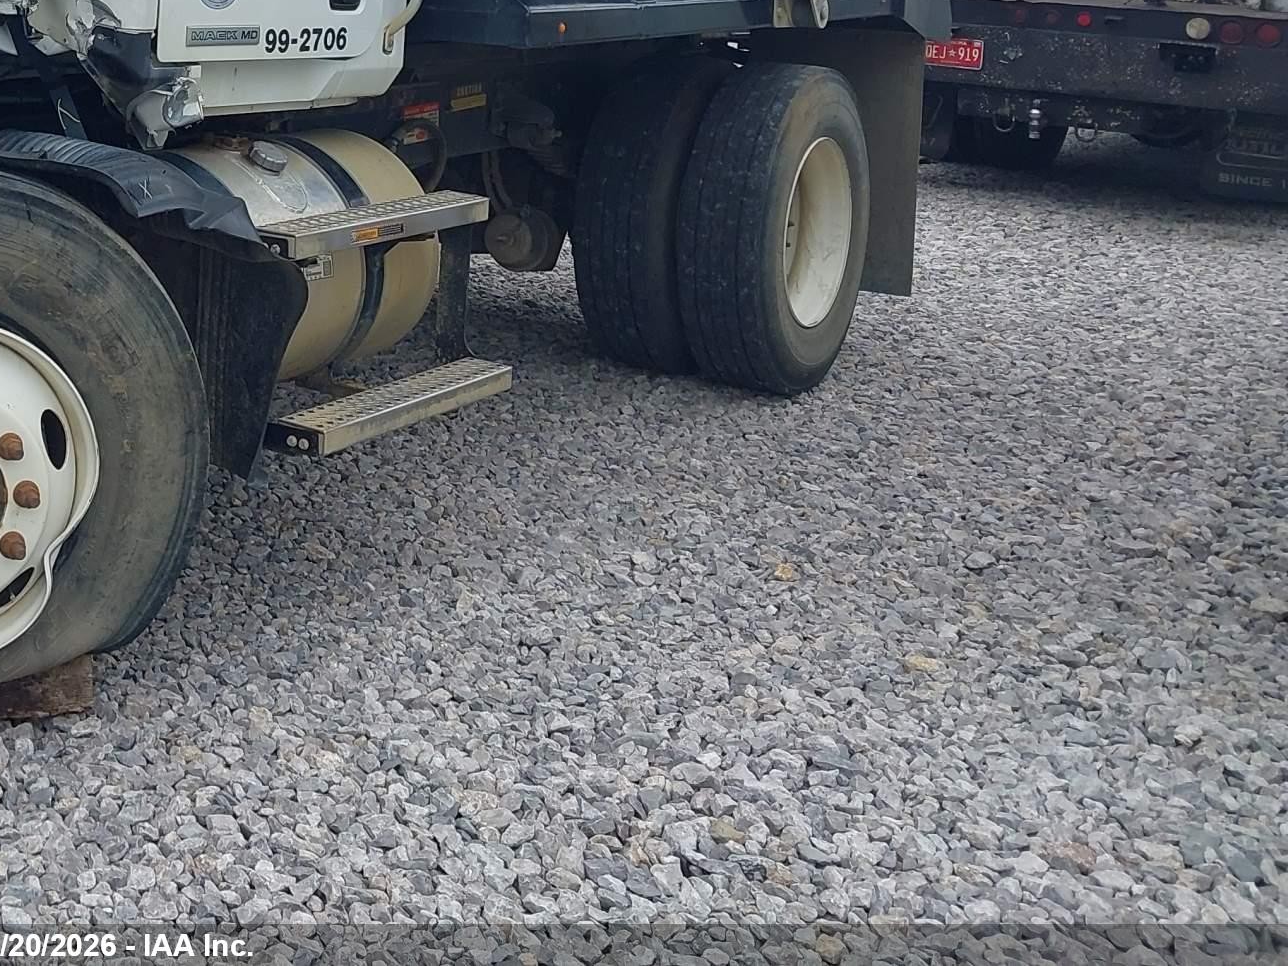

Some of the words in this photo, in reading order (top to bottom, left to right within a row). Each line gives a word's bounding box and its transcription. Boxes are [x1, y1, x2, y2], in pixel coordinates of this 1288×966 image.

[191, 31, 238, 41] MACK
[240, 30, 258, 40] MD
[265, 27, 348, 53] 99-2706
[1218, 172, 1272, 186] SINCE
